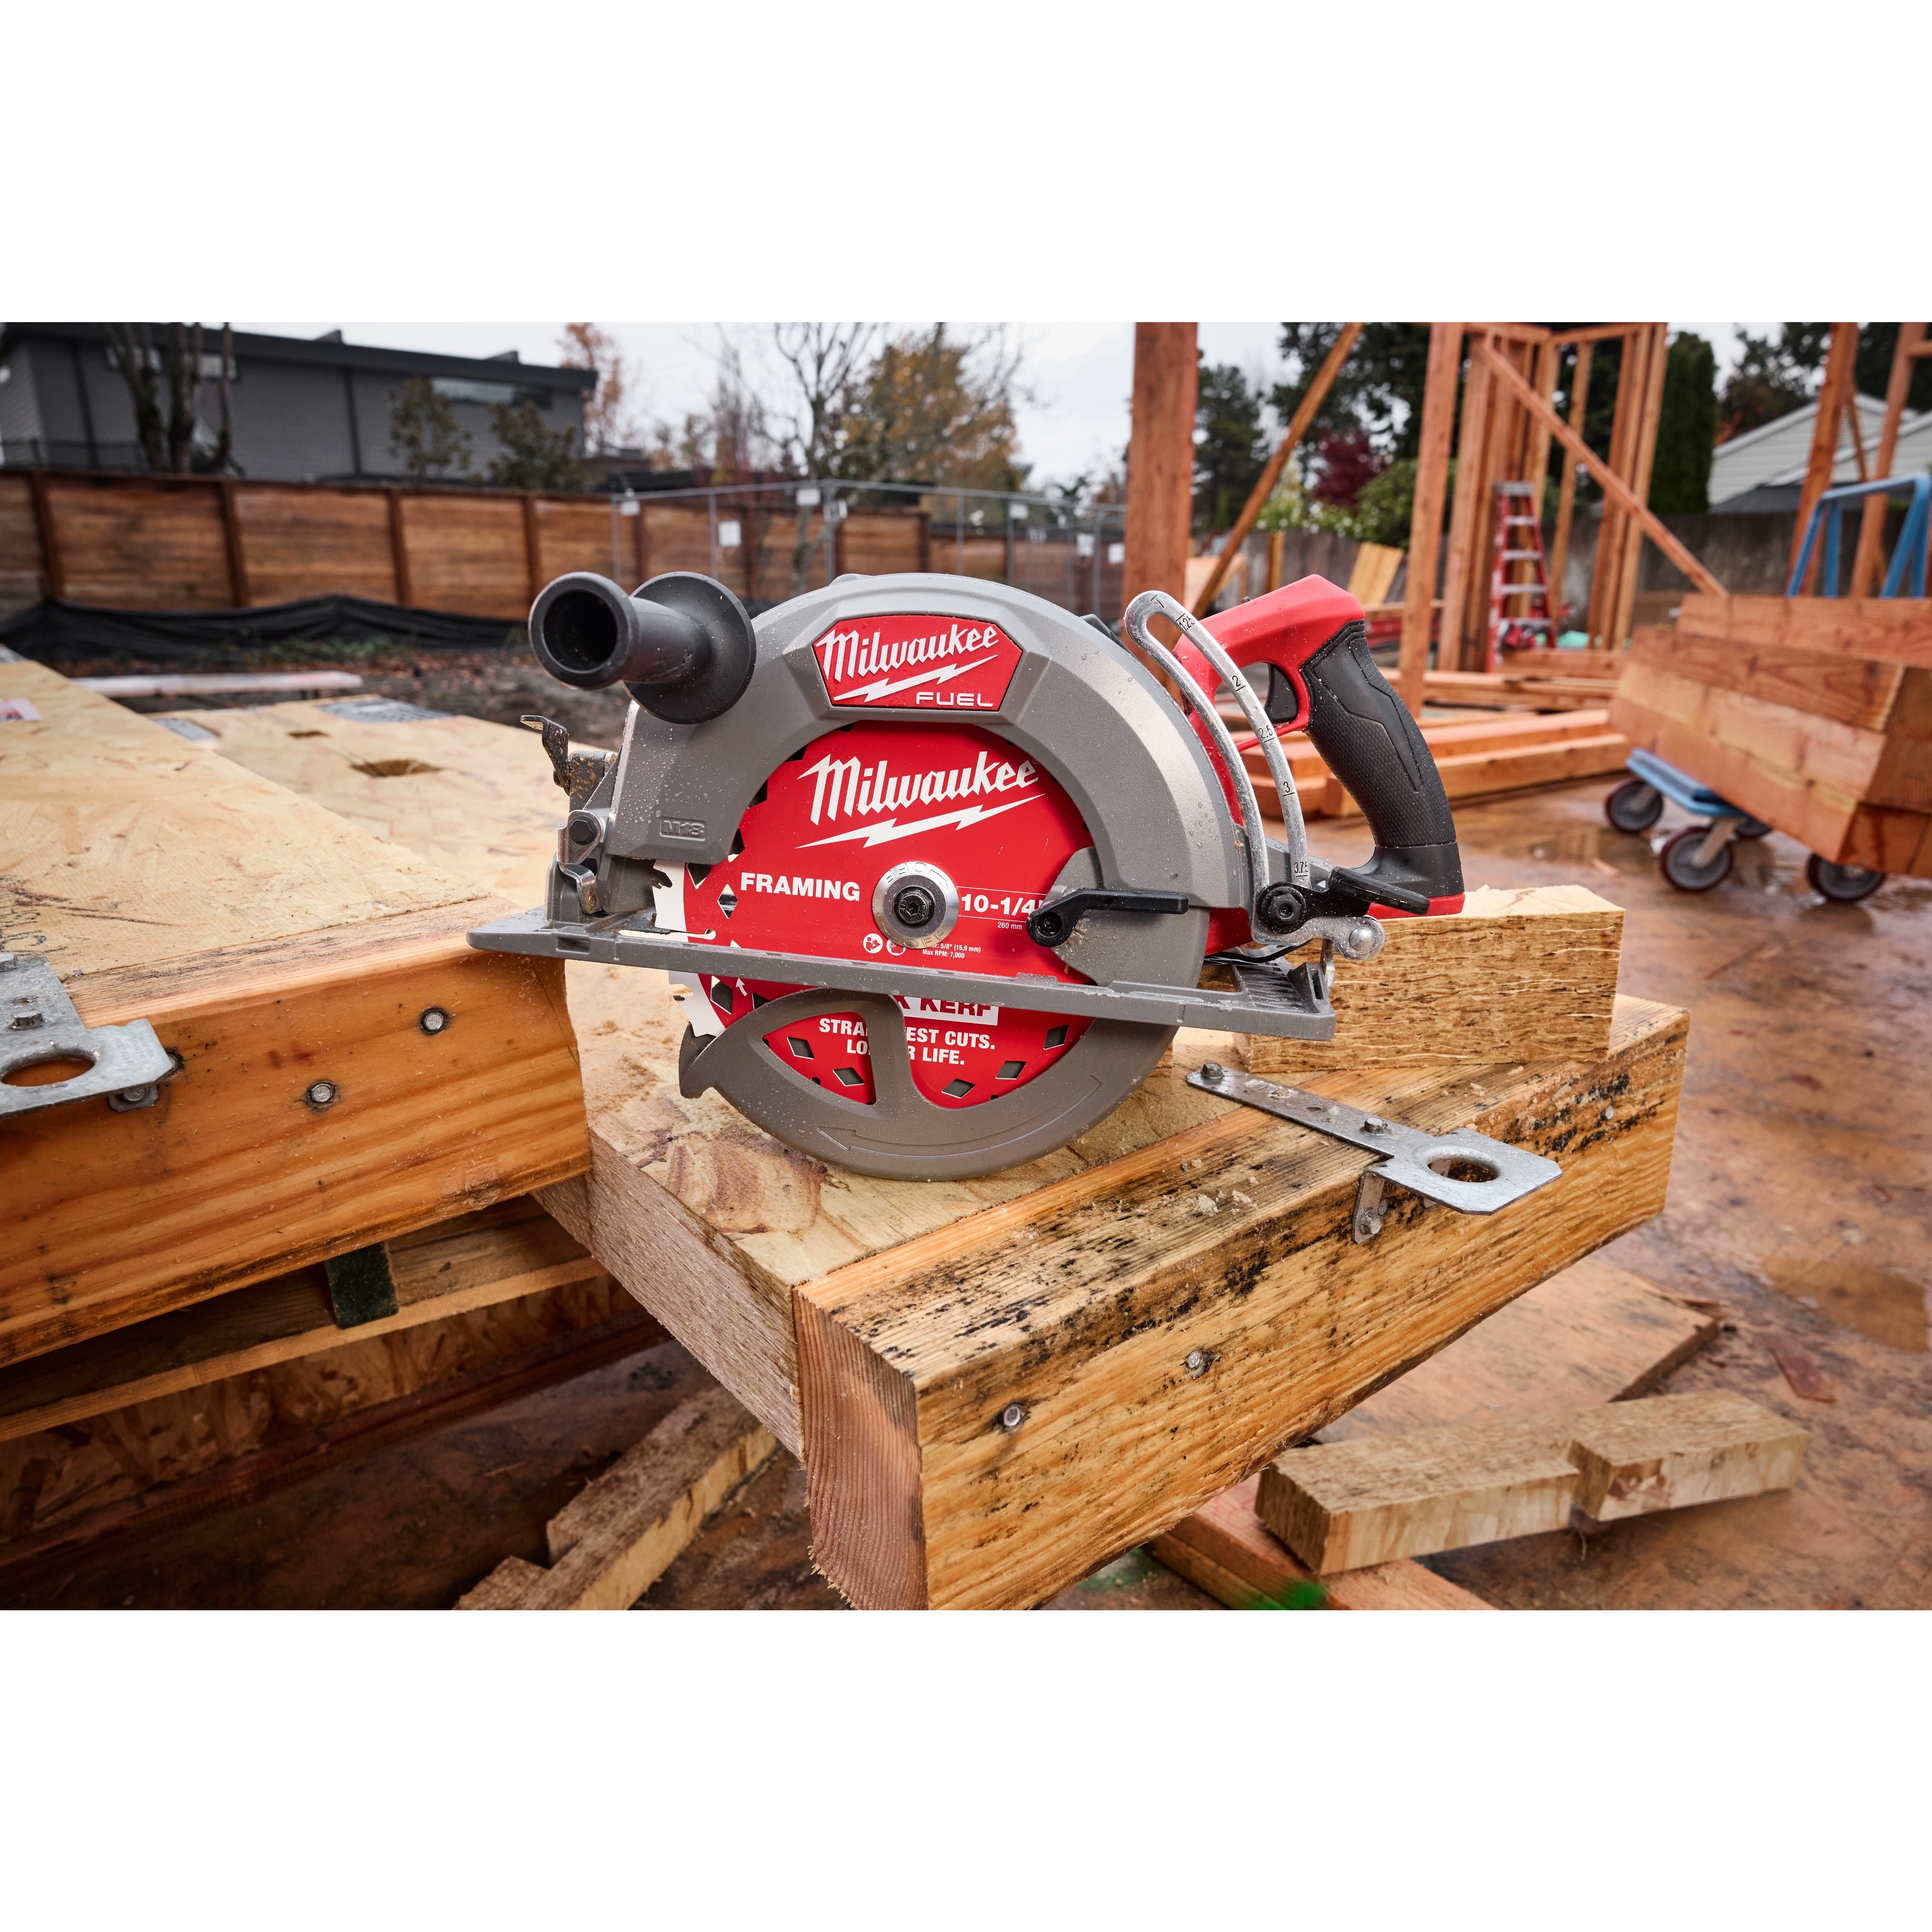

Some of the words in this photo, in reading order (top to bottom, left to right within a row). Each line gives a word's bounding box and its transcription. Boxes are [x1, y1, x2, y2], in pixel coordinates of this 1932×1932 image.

[1179, 615, 1195, 631] 1.25
[816, 624, 998, 682] Milwaukee
[1232, 676, 1241, 687] 2
[916, 692, 993, 707] FUEL
[1258, 725, 1273, 739] 2.5
[797, 752, 1038, 825] Milwaukee
[1283, 781, 1290, 793] 3
[1294, 862, 1308, 873] 3.75
[740, 872, 860, 901] FRAMING
[903, 929, 944, 949] OFF
[945, 1031, 995, 1050] CUTS.
[922, 1047, 965, 1065] LIFE.
